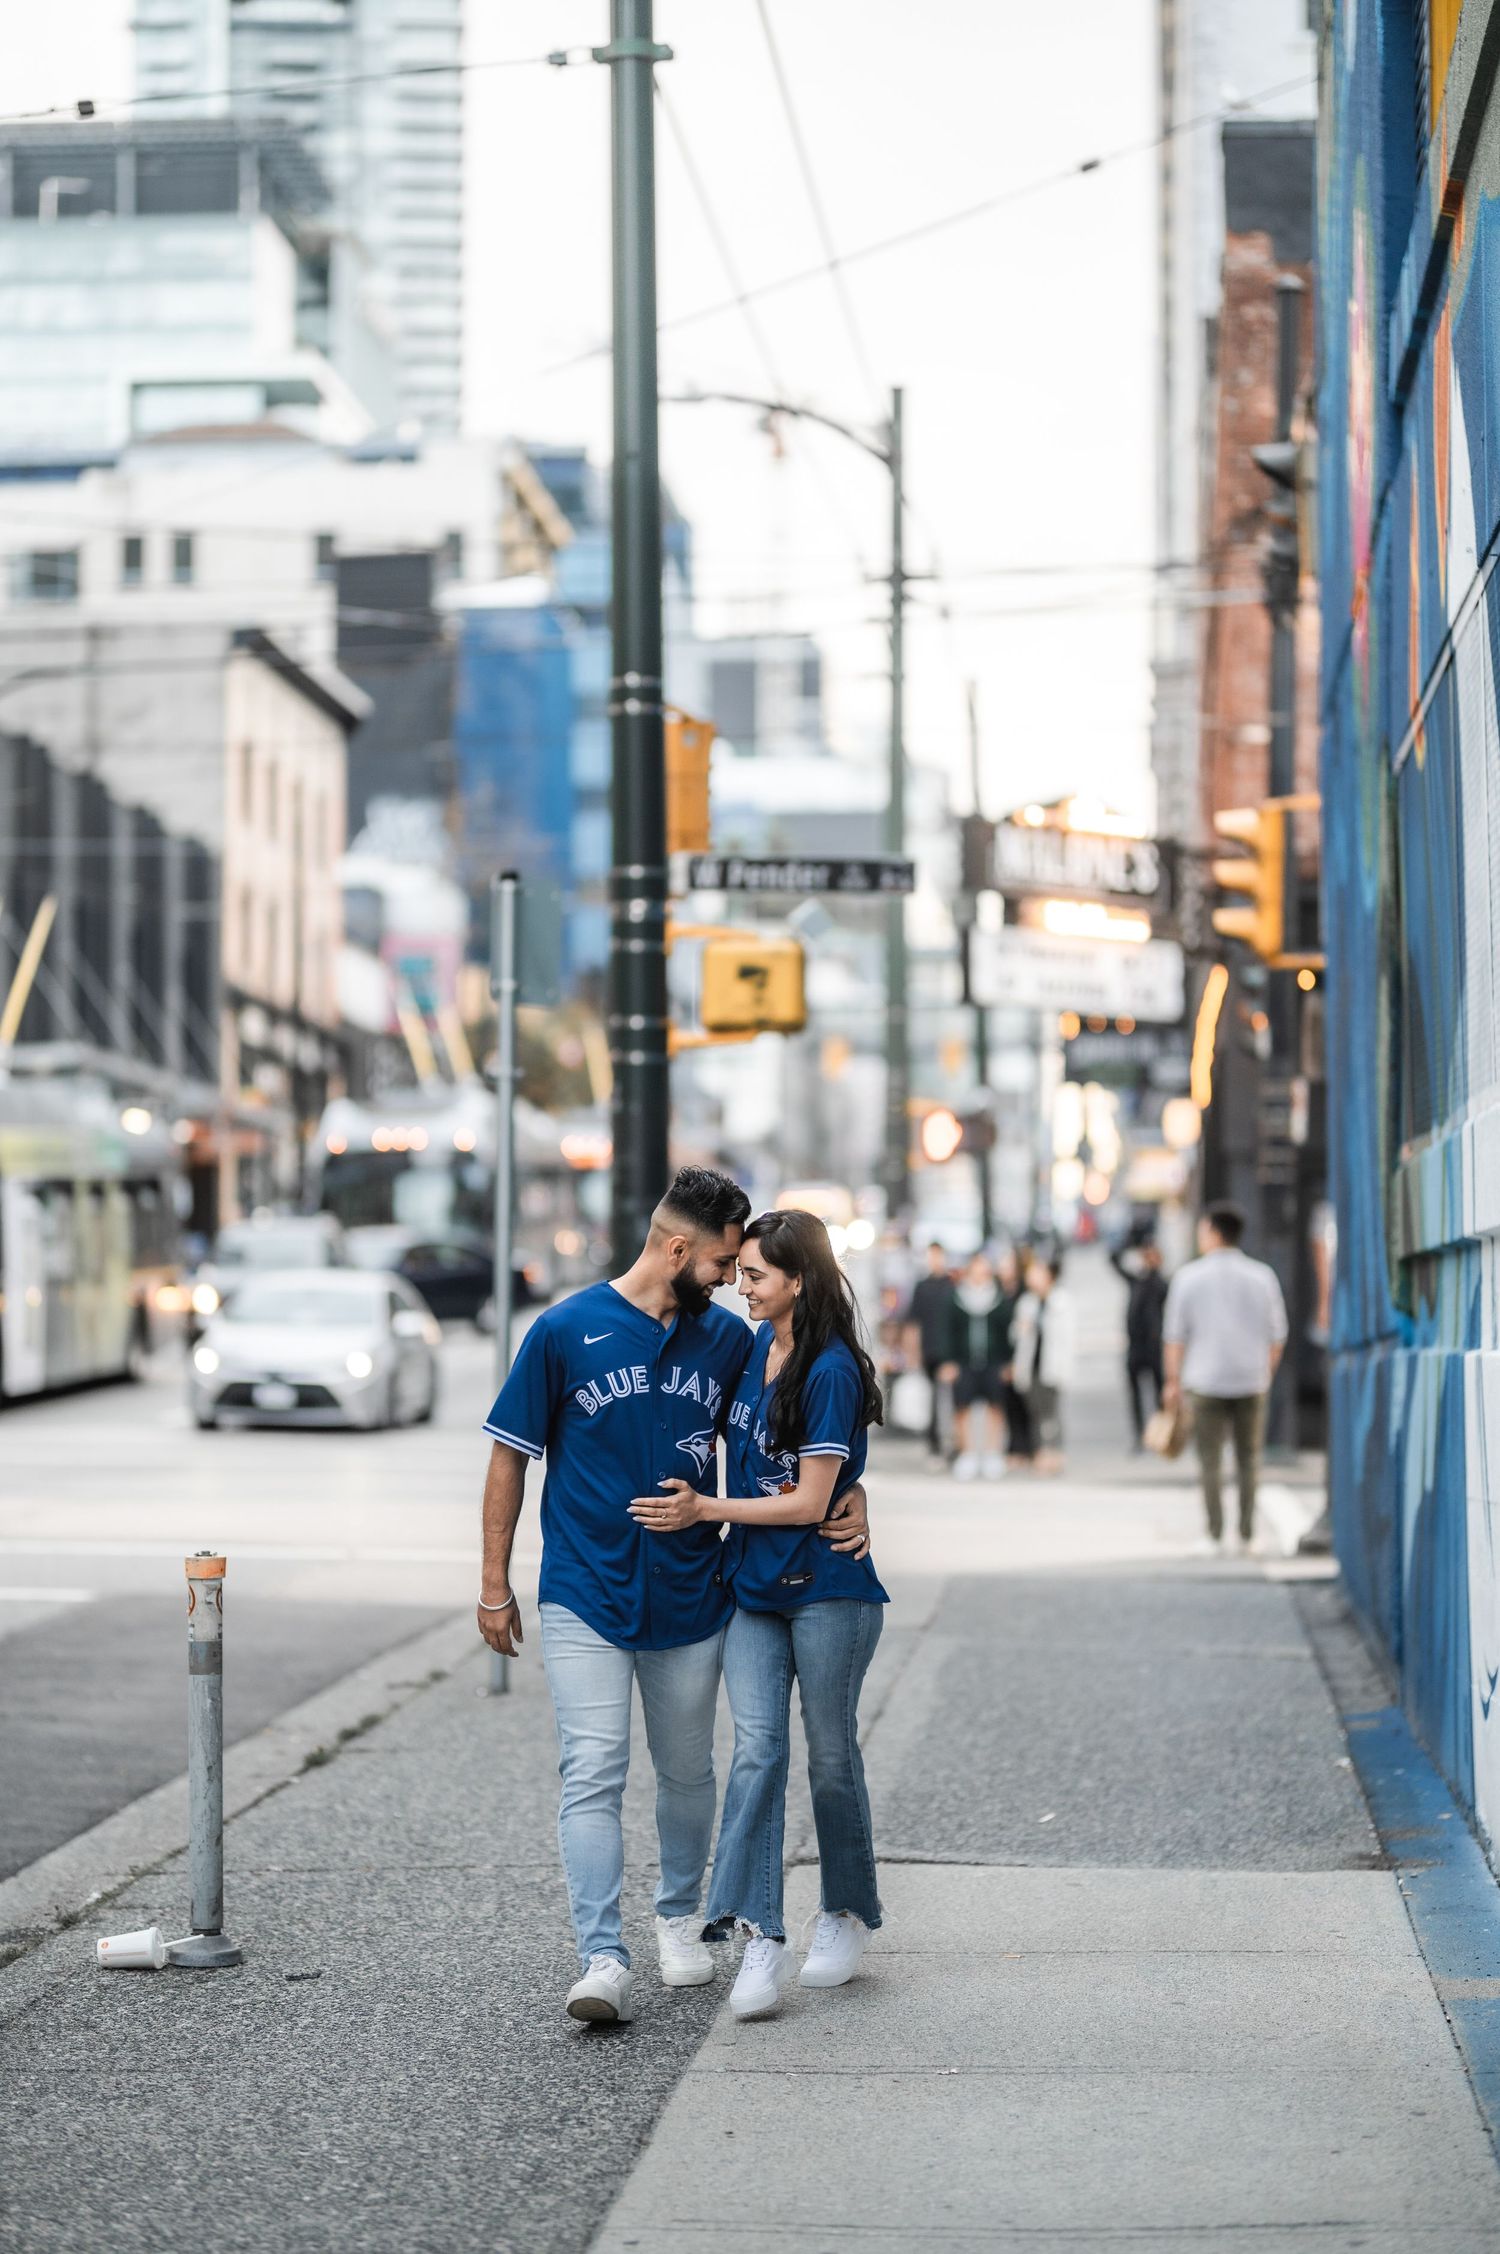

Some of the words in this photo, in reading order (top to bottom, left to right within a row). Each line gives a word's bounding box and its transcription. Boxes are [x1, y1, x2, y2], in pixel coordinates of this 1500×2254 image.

[726, 860, 829, 889] Pender
[575, 1365, 650, 1416] BLUE
[660, 1366, 722, 1419] JAYS
[728, 1401, 751, 1430] UE
[753, 1419, 798, 1469] JAS
